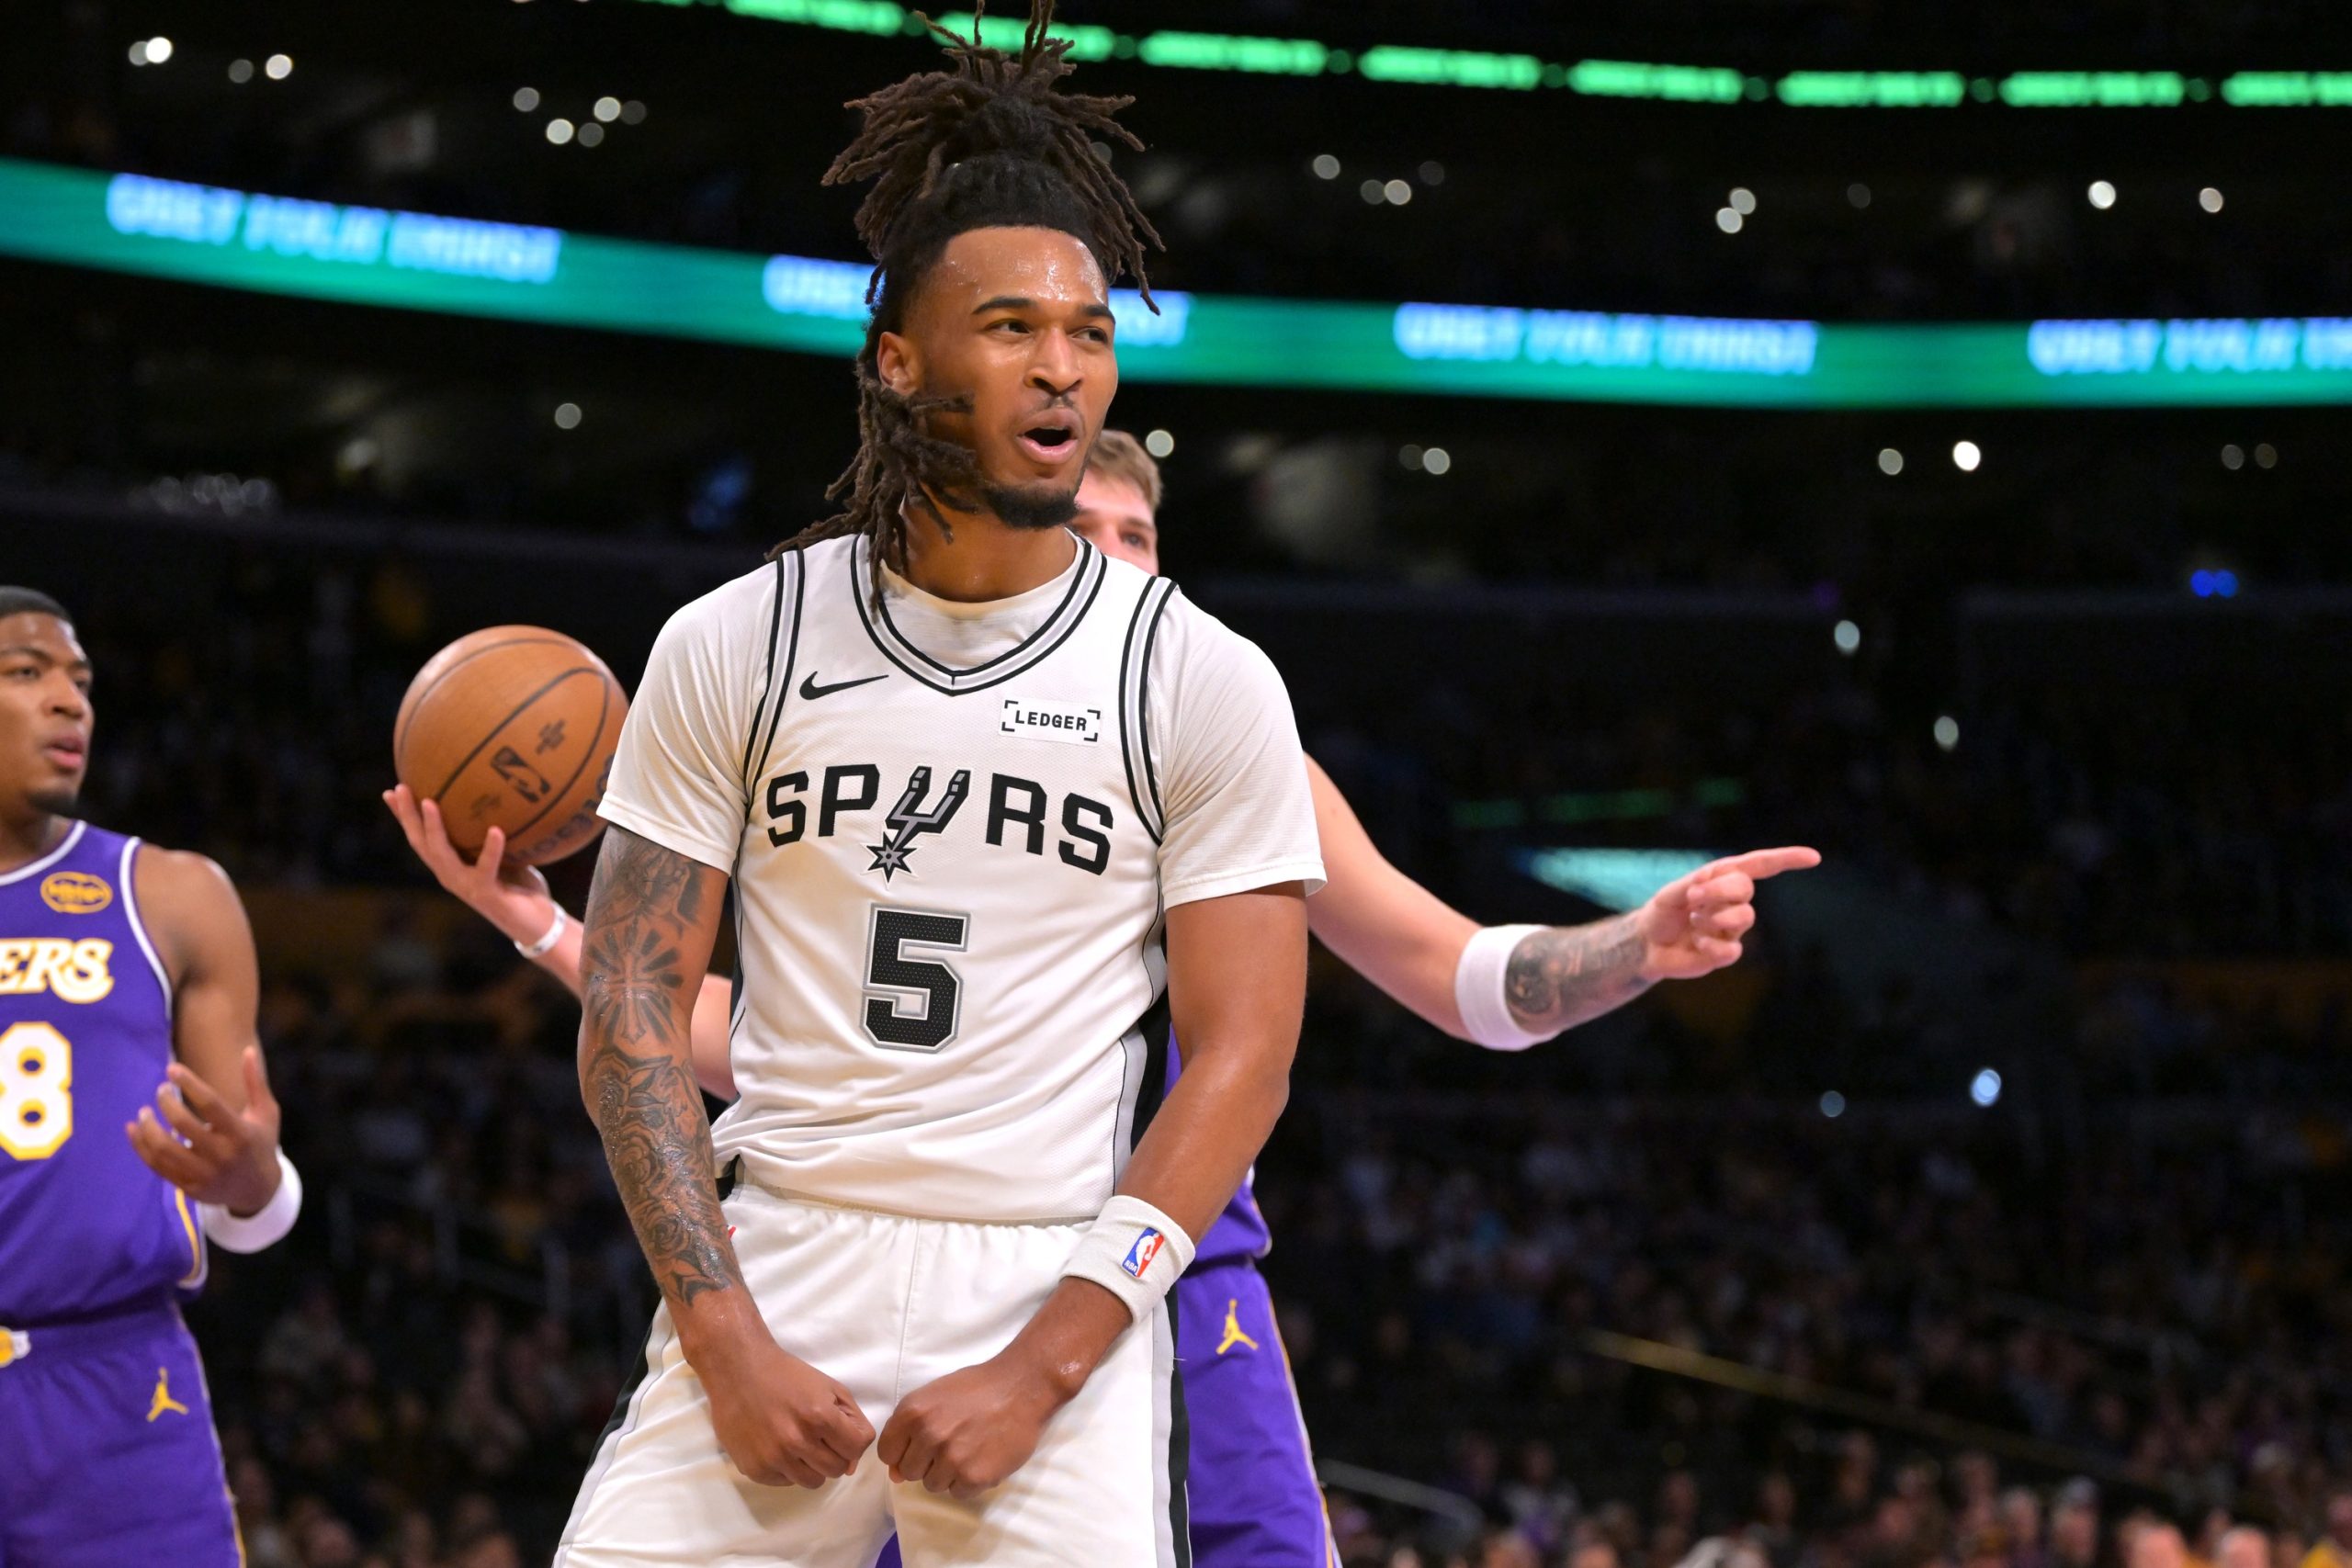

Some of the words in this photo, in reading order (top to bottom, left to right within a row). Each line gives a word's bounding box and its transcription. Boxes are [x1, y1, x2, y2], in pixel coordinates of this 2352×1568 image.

[1014, 710, 1088, 732] LEDGER
[766, 763, 1114, 883] SPURS
[860, 903, 971, 1054] 5
[0, 1021, 73, 1160] 8
[1124, 1259, 1138, 1274] NBA
